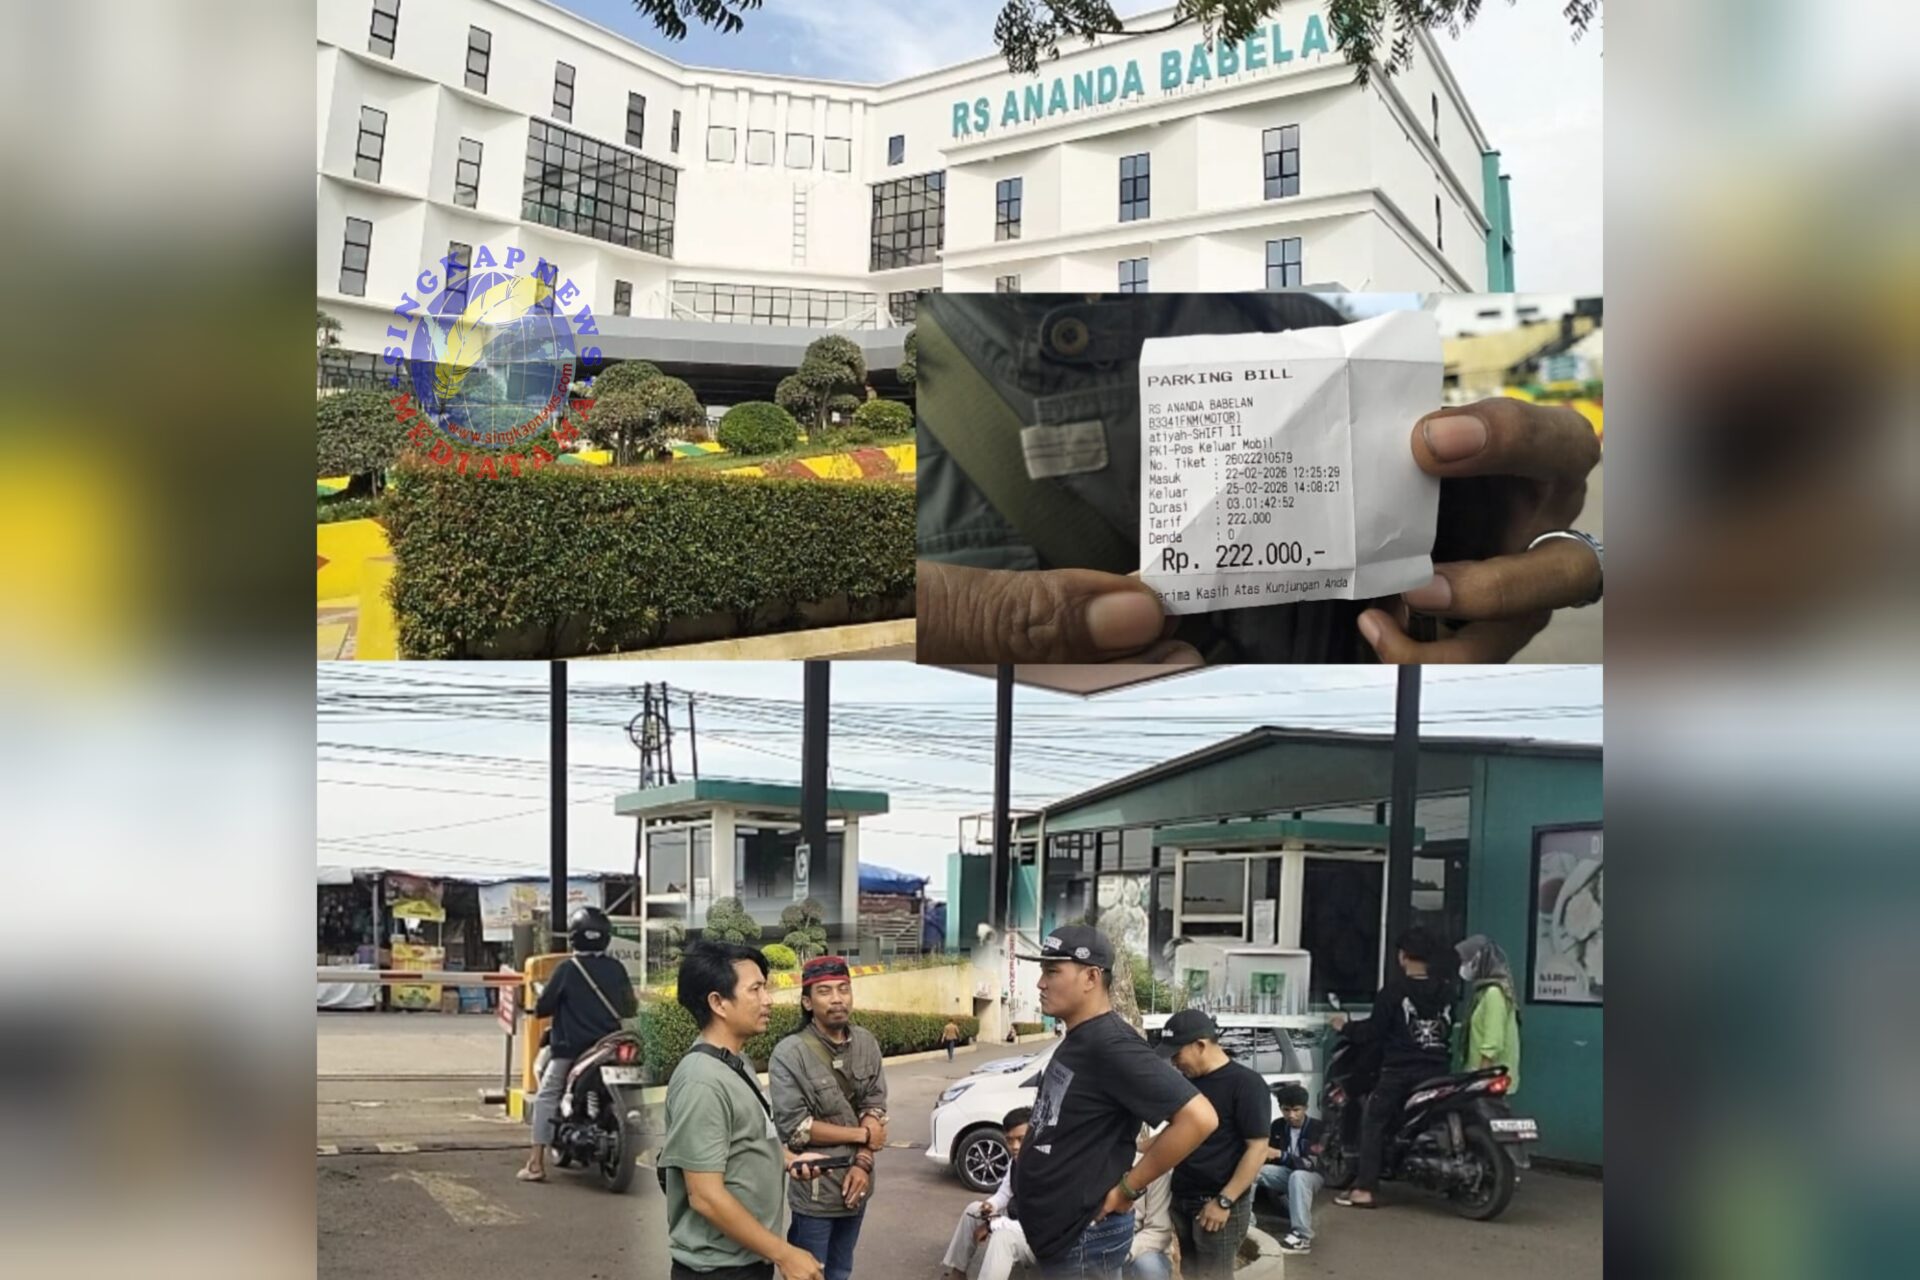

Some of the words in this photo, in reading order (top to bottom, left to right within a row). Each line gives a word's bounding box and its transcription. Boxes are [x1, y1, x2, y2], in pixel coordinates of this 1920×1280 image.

[952, 97, 990, 138] RS
[1001, 60, 1145, 127] ANANDA
[1160, 9, 1364, 90] BABELA
[1148, 371, 1233, 387] PARKING
[1245, 368, 1293, 381] BILL
[1148, 404, 1161, 414] RS
[1167, 401, 1204, 412] ANANDA
[1210, 397, 1253, 410] BABELAN
[1149, 428, 1223, 443] atiyah-SHIFT
[1230, 427, 1242, 437] II
[1149, 443, 1195, 456] PK1-Pos
[1199, 440, 1237, 453] Keluar
[1243, 437, 1273, 449] Mobil
[1149, 459, 1168, 471] No.
[1176, 457, 1206, 469] Tiket
[1225, 453, 1293, 465] 26022210579
[1149, 473, 1181, 484] Masuk
[1225, 467, 1287, 480] 22-02-2026
[1294, 466, 1340, 478] 12:25:29
[1149, 487, 1188, 499] Keluar
[1226, 483, 1288, 495] 25-02-2026
[1294, 481, 1340, 493] 14:08:21
[1149, 503, 1188, 514] Durasi
[1227, 497, 1294, 510] 03.01:42:52
[1149, 517, 1181, 529] Tarif
[1227, 513, 1271, 525] 222.000
[1149, 532, 1182, 545] Denda
[1228, 529, 1235, 541] 0
[1162, 548, 1200, 573] Rp.
[1216, 542, 1326, 568] 222.000,-
[1156, 589, 1190, 601] erima
[1197, 586, 1229, 599] Kasih
[1235, 583, 1260, 596] Atas
[1266, 580, 1320, 594] Kunjungan
[1325, 578, 1348, 589] Anda
